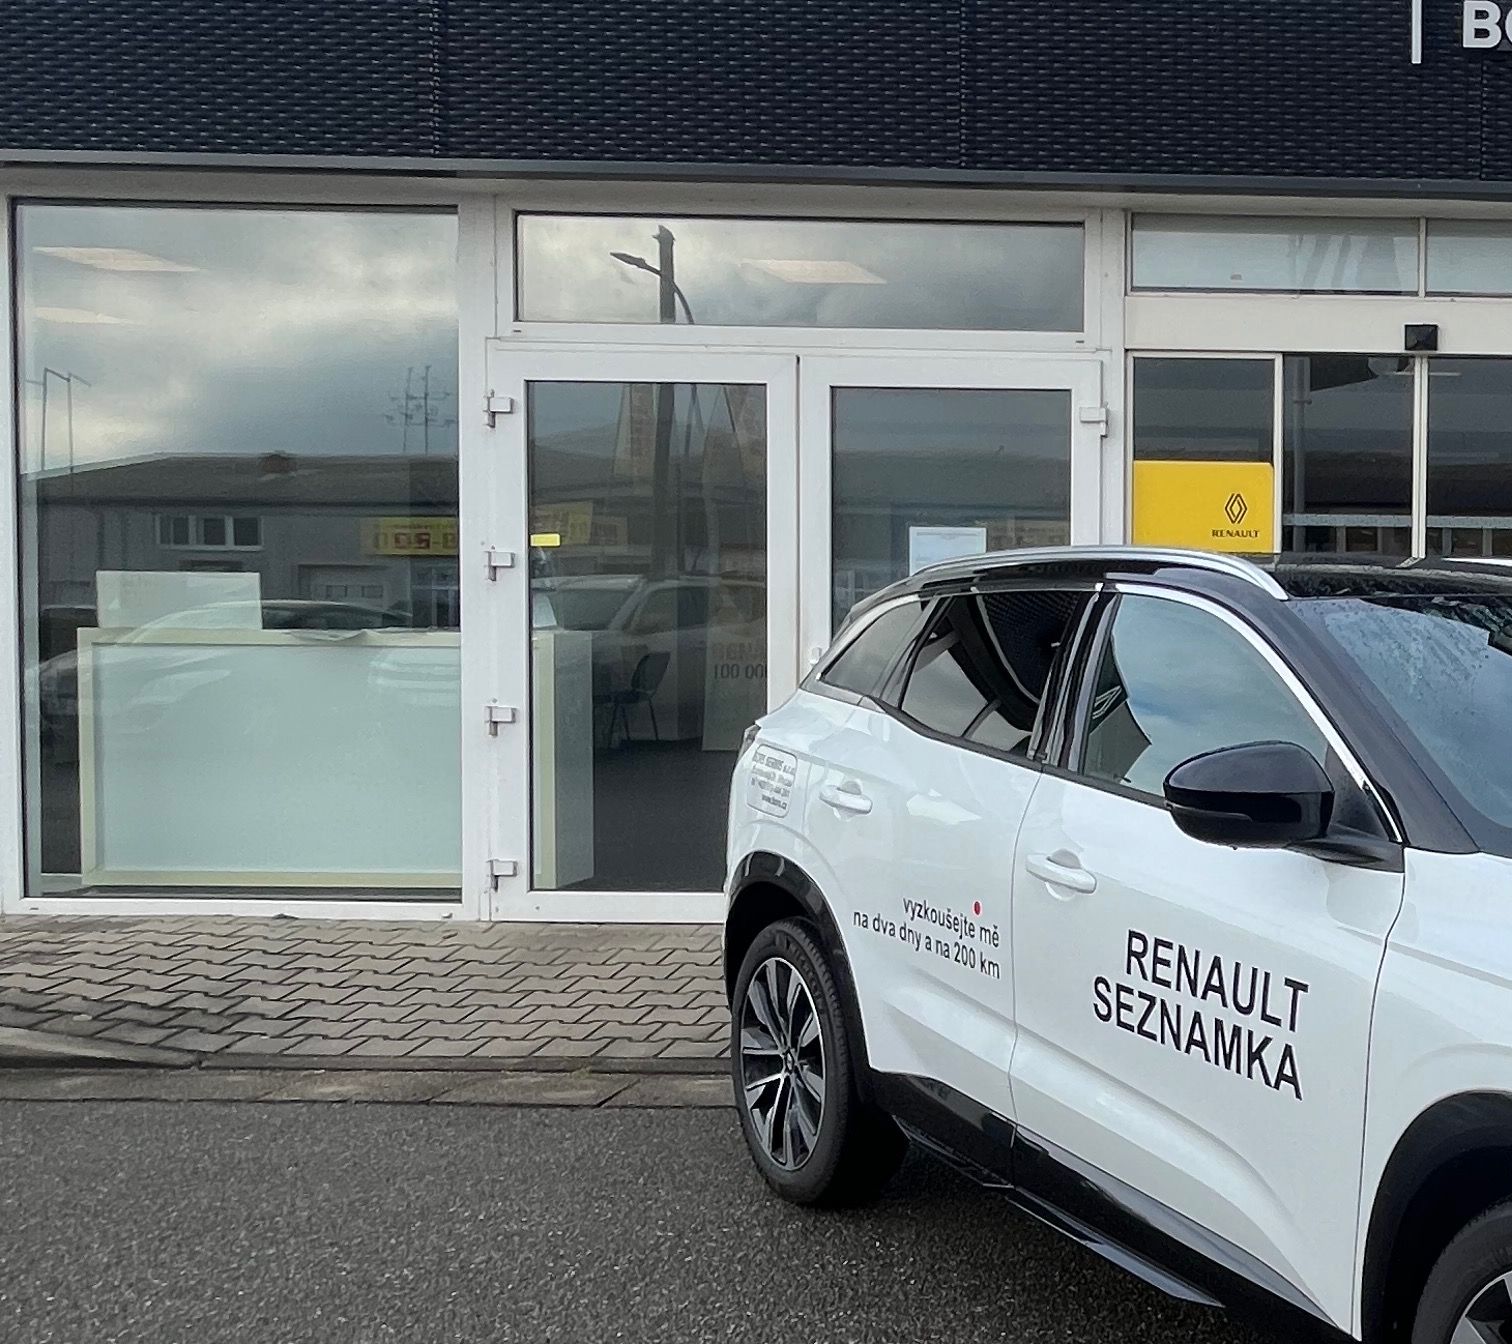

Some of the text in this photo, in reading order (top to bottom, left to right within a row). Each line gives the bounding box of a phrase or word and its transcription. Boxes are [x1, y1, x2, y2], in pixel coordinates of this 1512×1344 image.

[1211, 528, 1259, 538] RENAULT
[714, 663, 740, 680] 100
[853, 910, 1000, 980] na dva dny a na 200 km
[902, 896, 1000, 948] vyzkoušejte mě
[1126, 929, 1309, 1033] RENAULT
[1093, 975, 1303, 1101] SEZNAMKA
